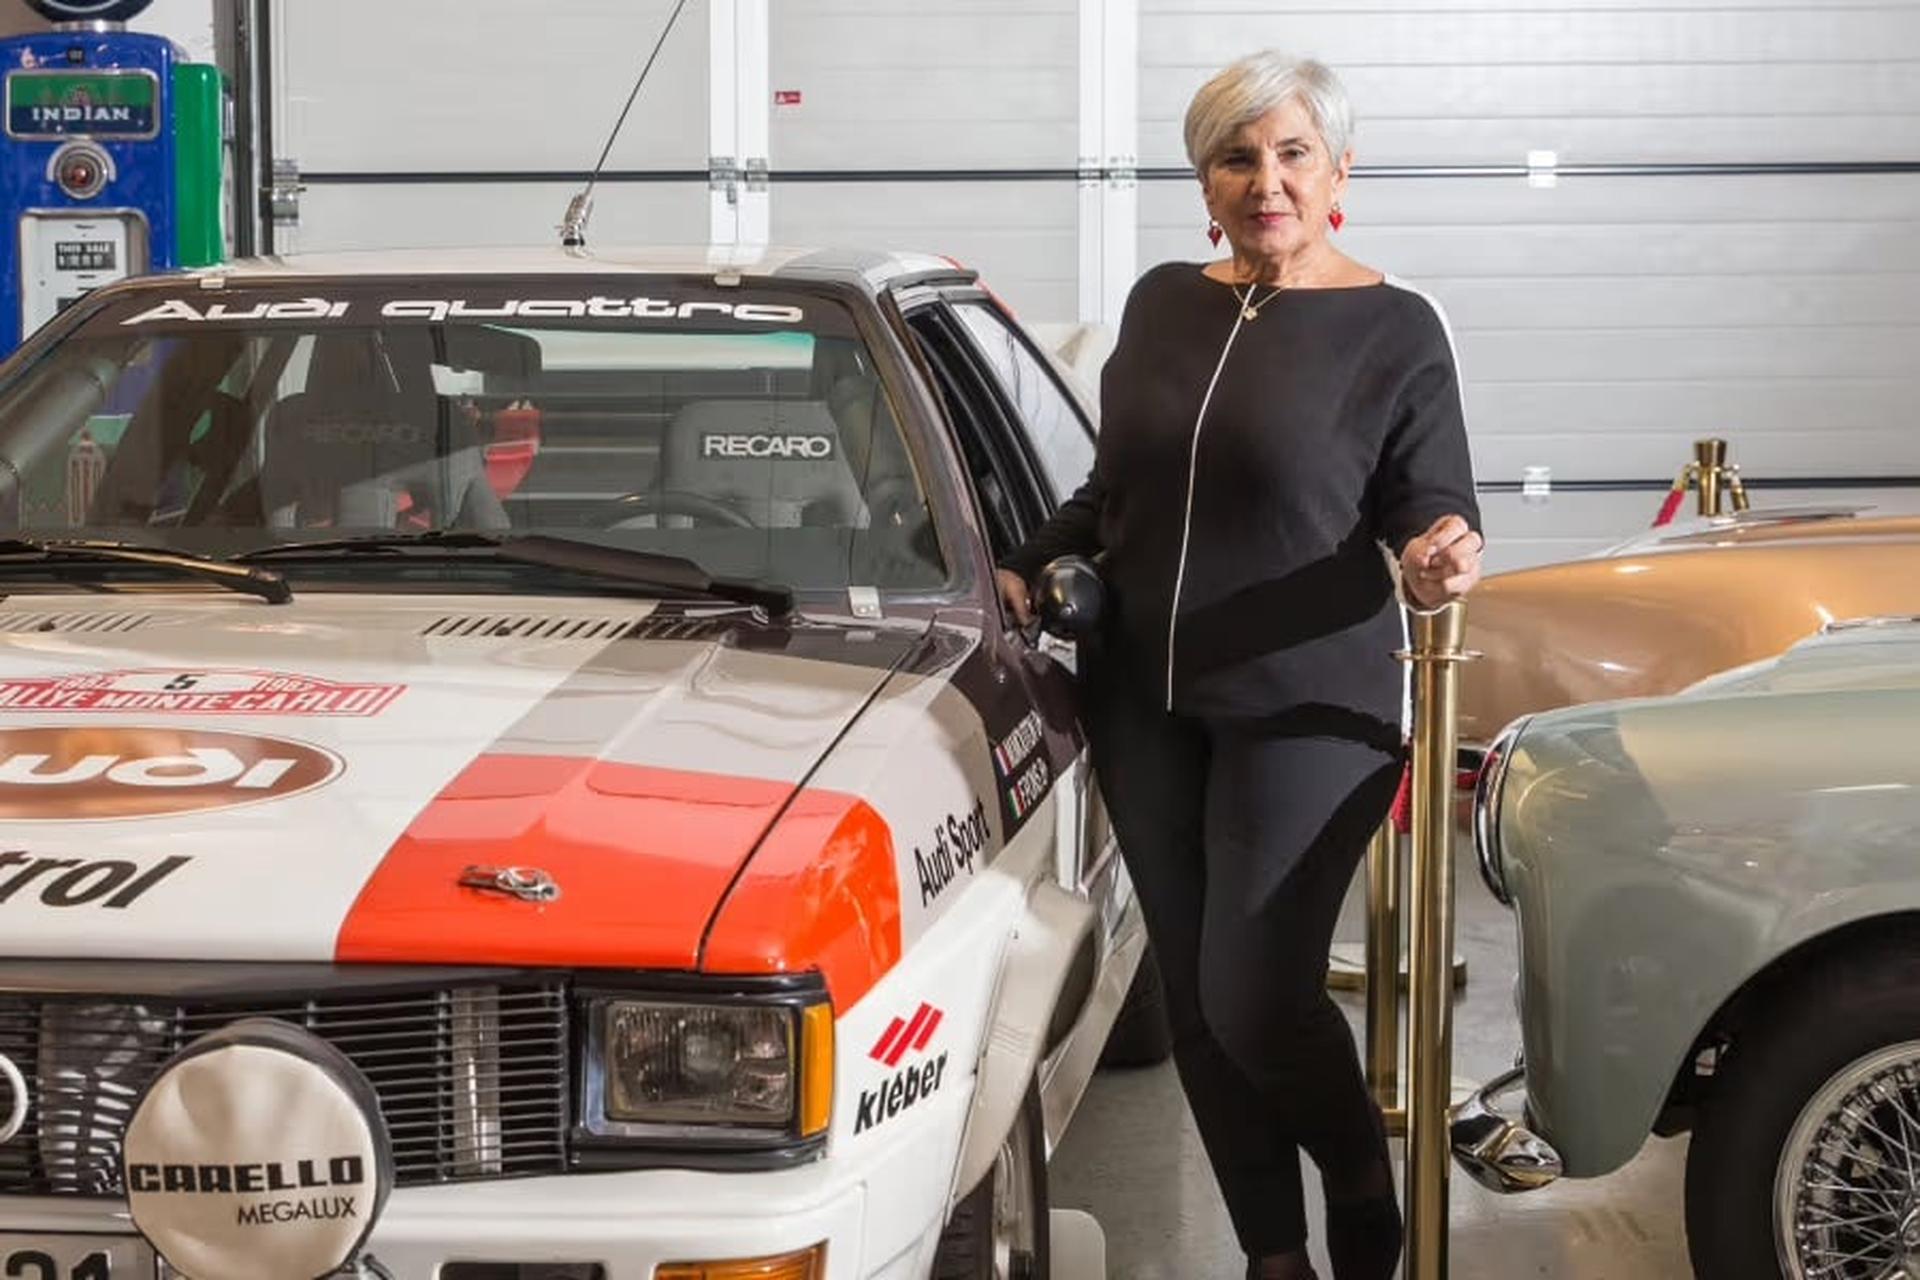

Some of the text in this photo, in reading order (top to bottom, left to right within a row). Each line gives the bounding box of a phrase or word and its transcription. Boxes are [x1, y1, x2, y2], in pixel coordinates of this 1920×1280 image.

[32, 105, 129, 120] INDIAN
[119, 296, 803, 325] Audi quattro
[704, 435, 831, 457] RECARO
[164, 673, 202, 690] 5
[914, 795, 990, 908] Audi Sport
[129, 1155, 364, 1194] CARELLO
[237, 1197, 356, 1226] MEGALUX
